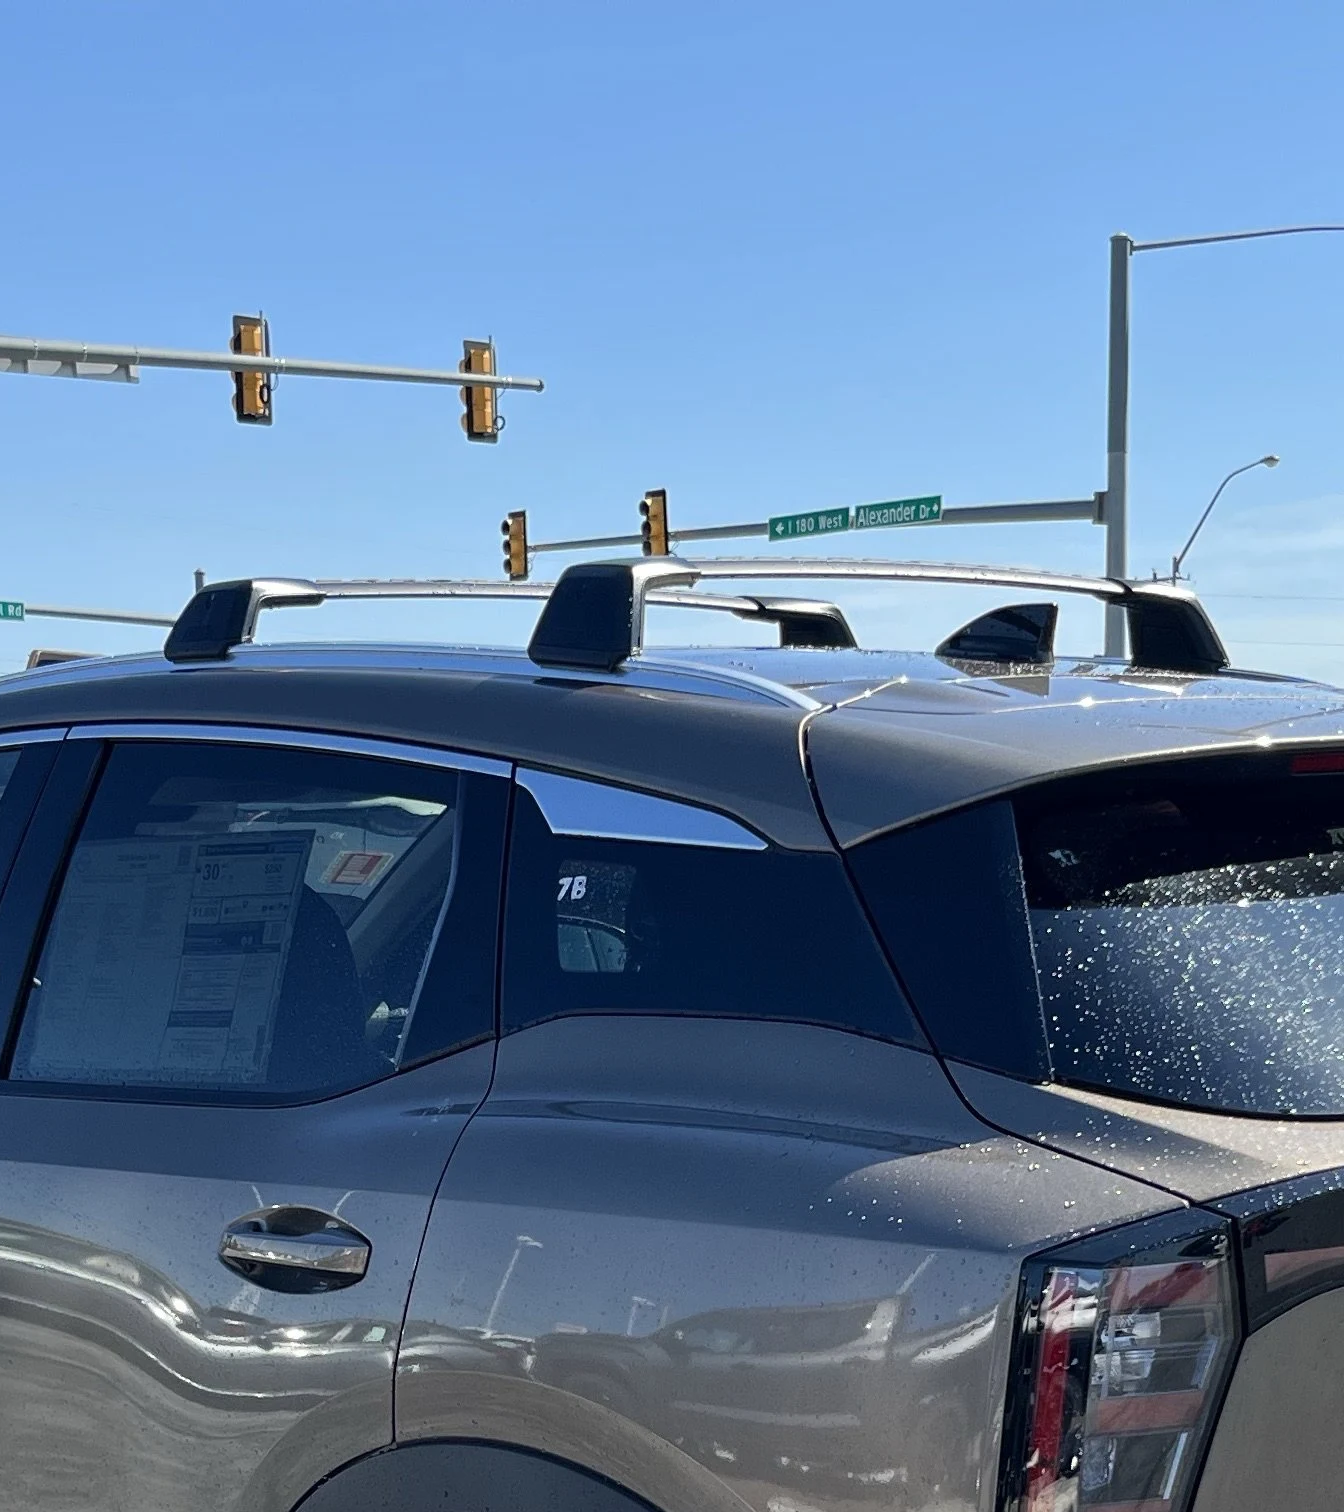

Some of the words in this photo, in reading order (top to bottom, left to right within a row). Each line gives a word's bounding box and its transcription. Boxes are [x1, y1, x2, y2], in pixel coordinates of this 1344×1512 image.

[796, 516, 814, 533] 180
[818, 514, 843, 529] West
[857, 504, 916, 527] Alexander
[919, 505, 931, 519] Dr
[7, 605, 22, 617] Rd
[202, 863, 220, 880] 30
